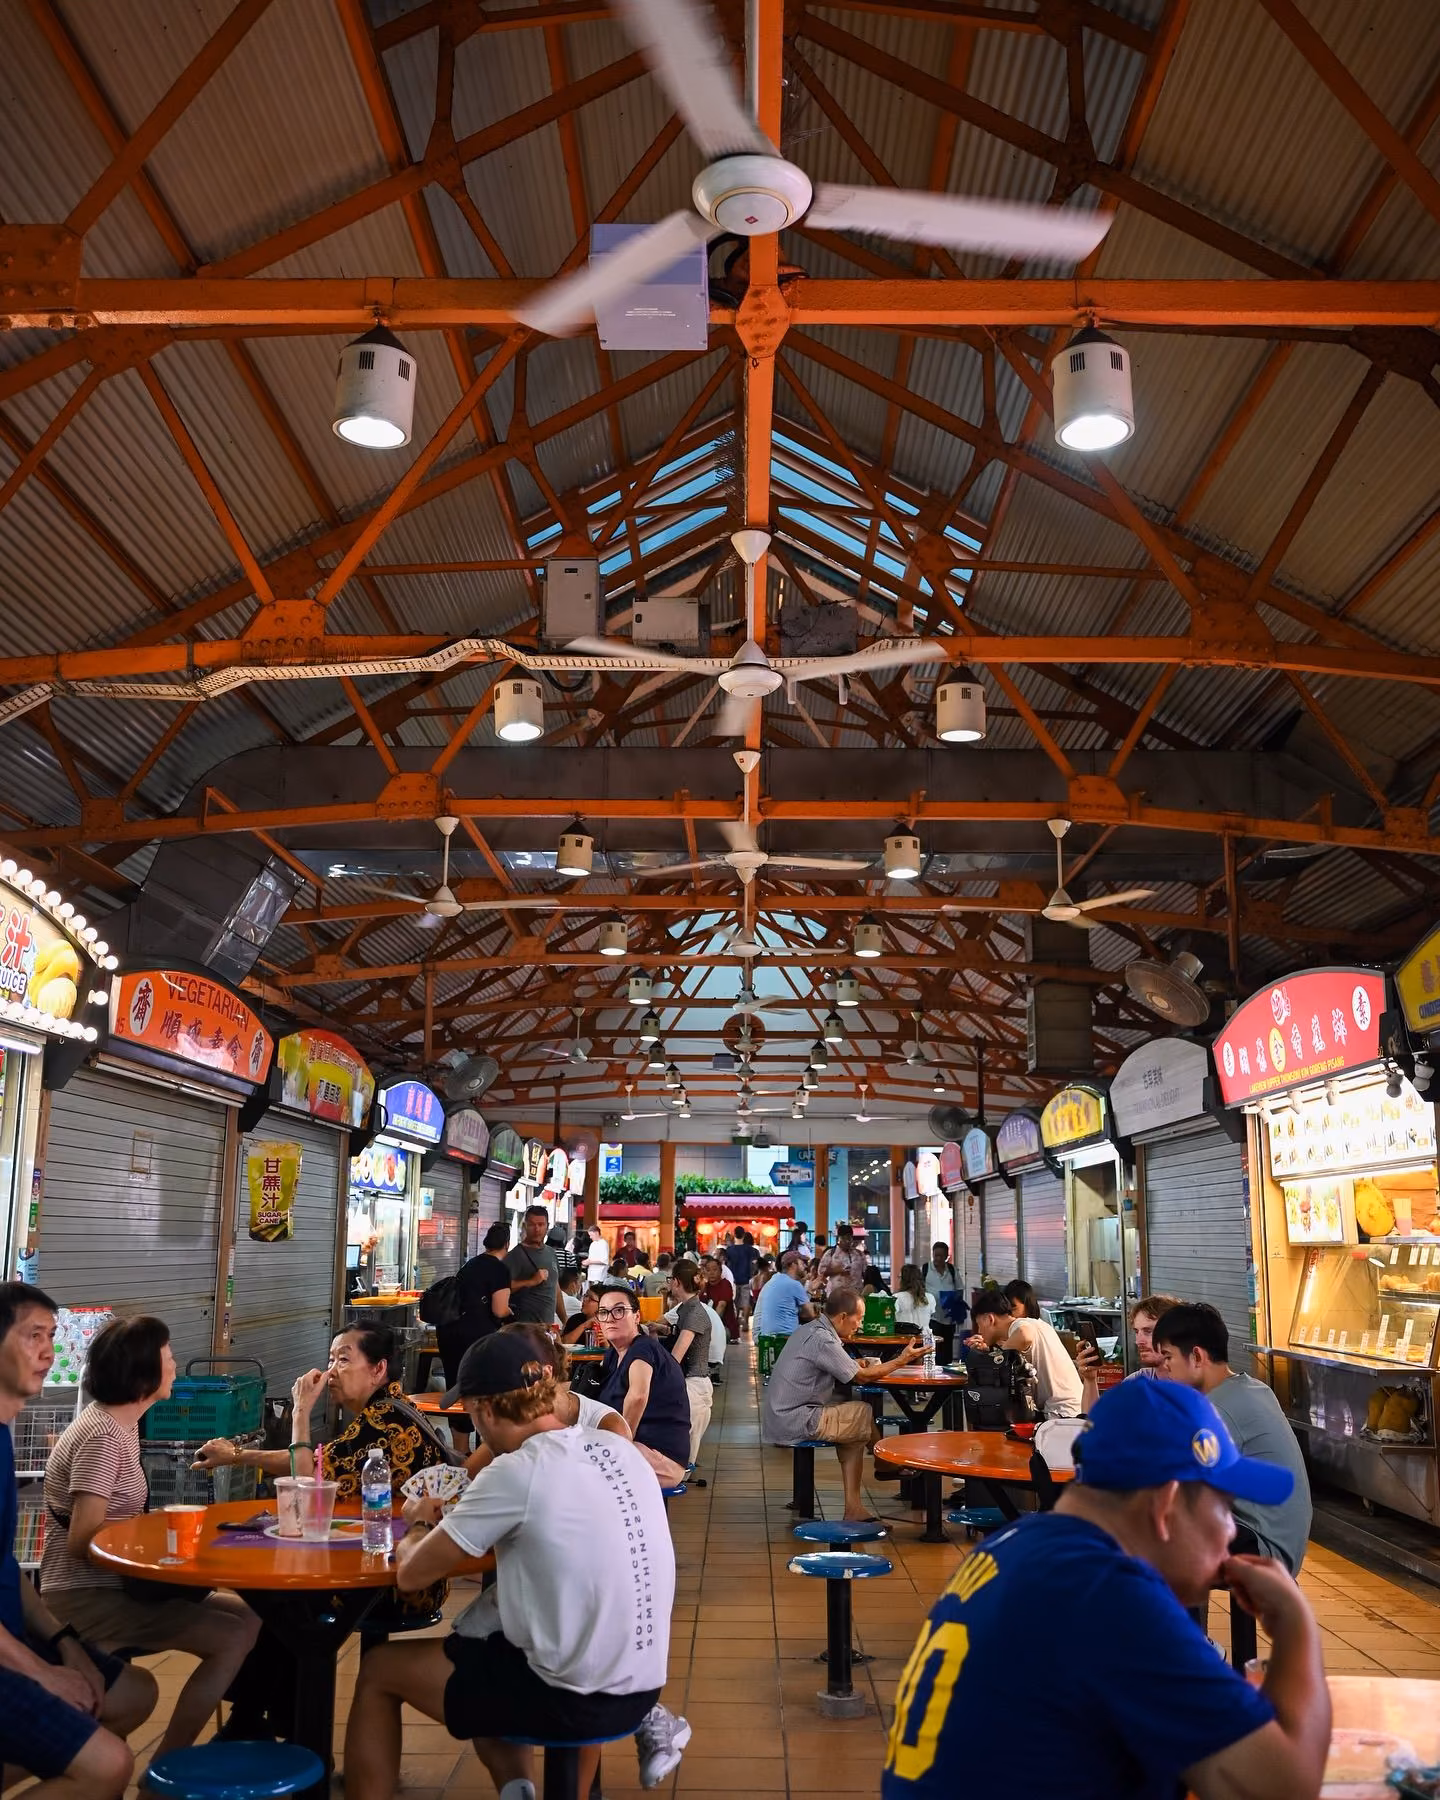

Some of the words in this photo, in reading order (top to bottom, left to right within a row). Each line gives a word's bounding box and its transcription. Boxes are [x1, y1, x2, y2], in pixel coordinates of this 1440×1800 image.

[0, 968, 26, 992] UICE
[167, 975, 250, 1032] VEGETARIAN
[1327, 1055, 1345, 1070] PISANG
[261, 1157, 282, 1209] 甘蔗汁
[259, 1217, 279, 1225] CANE
